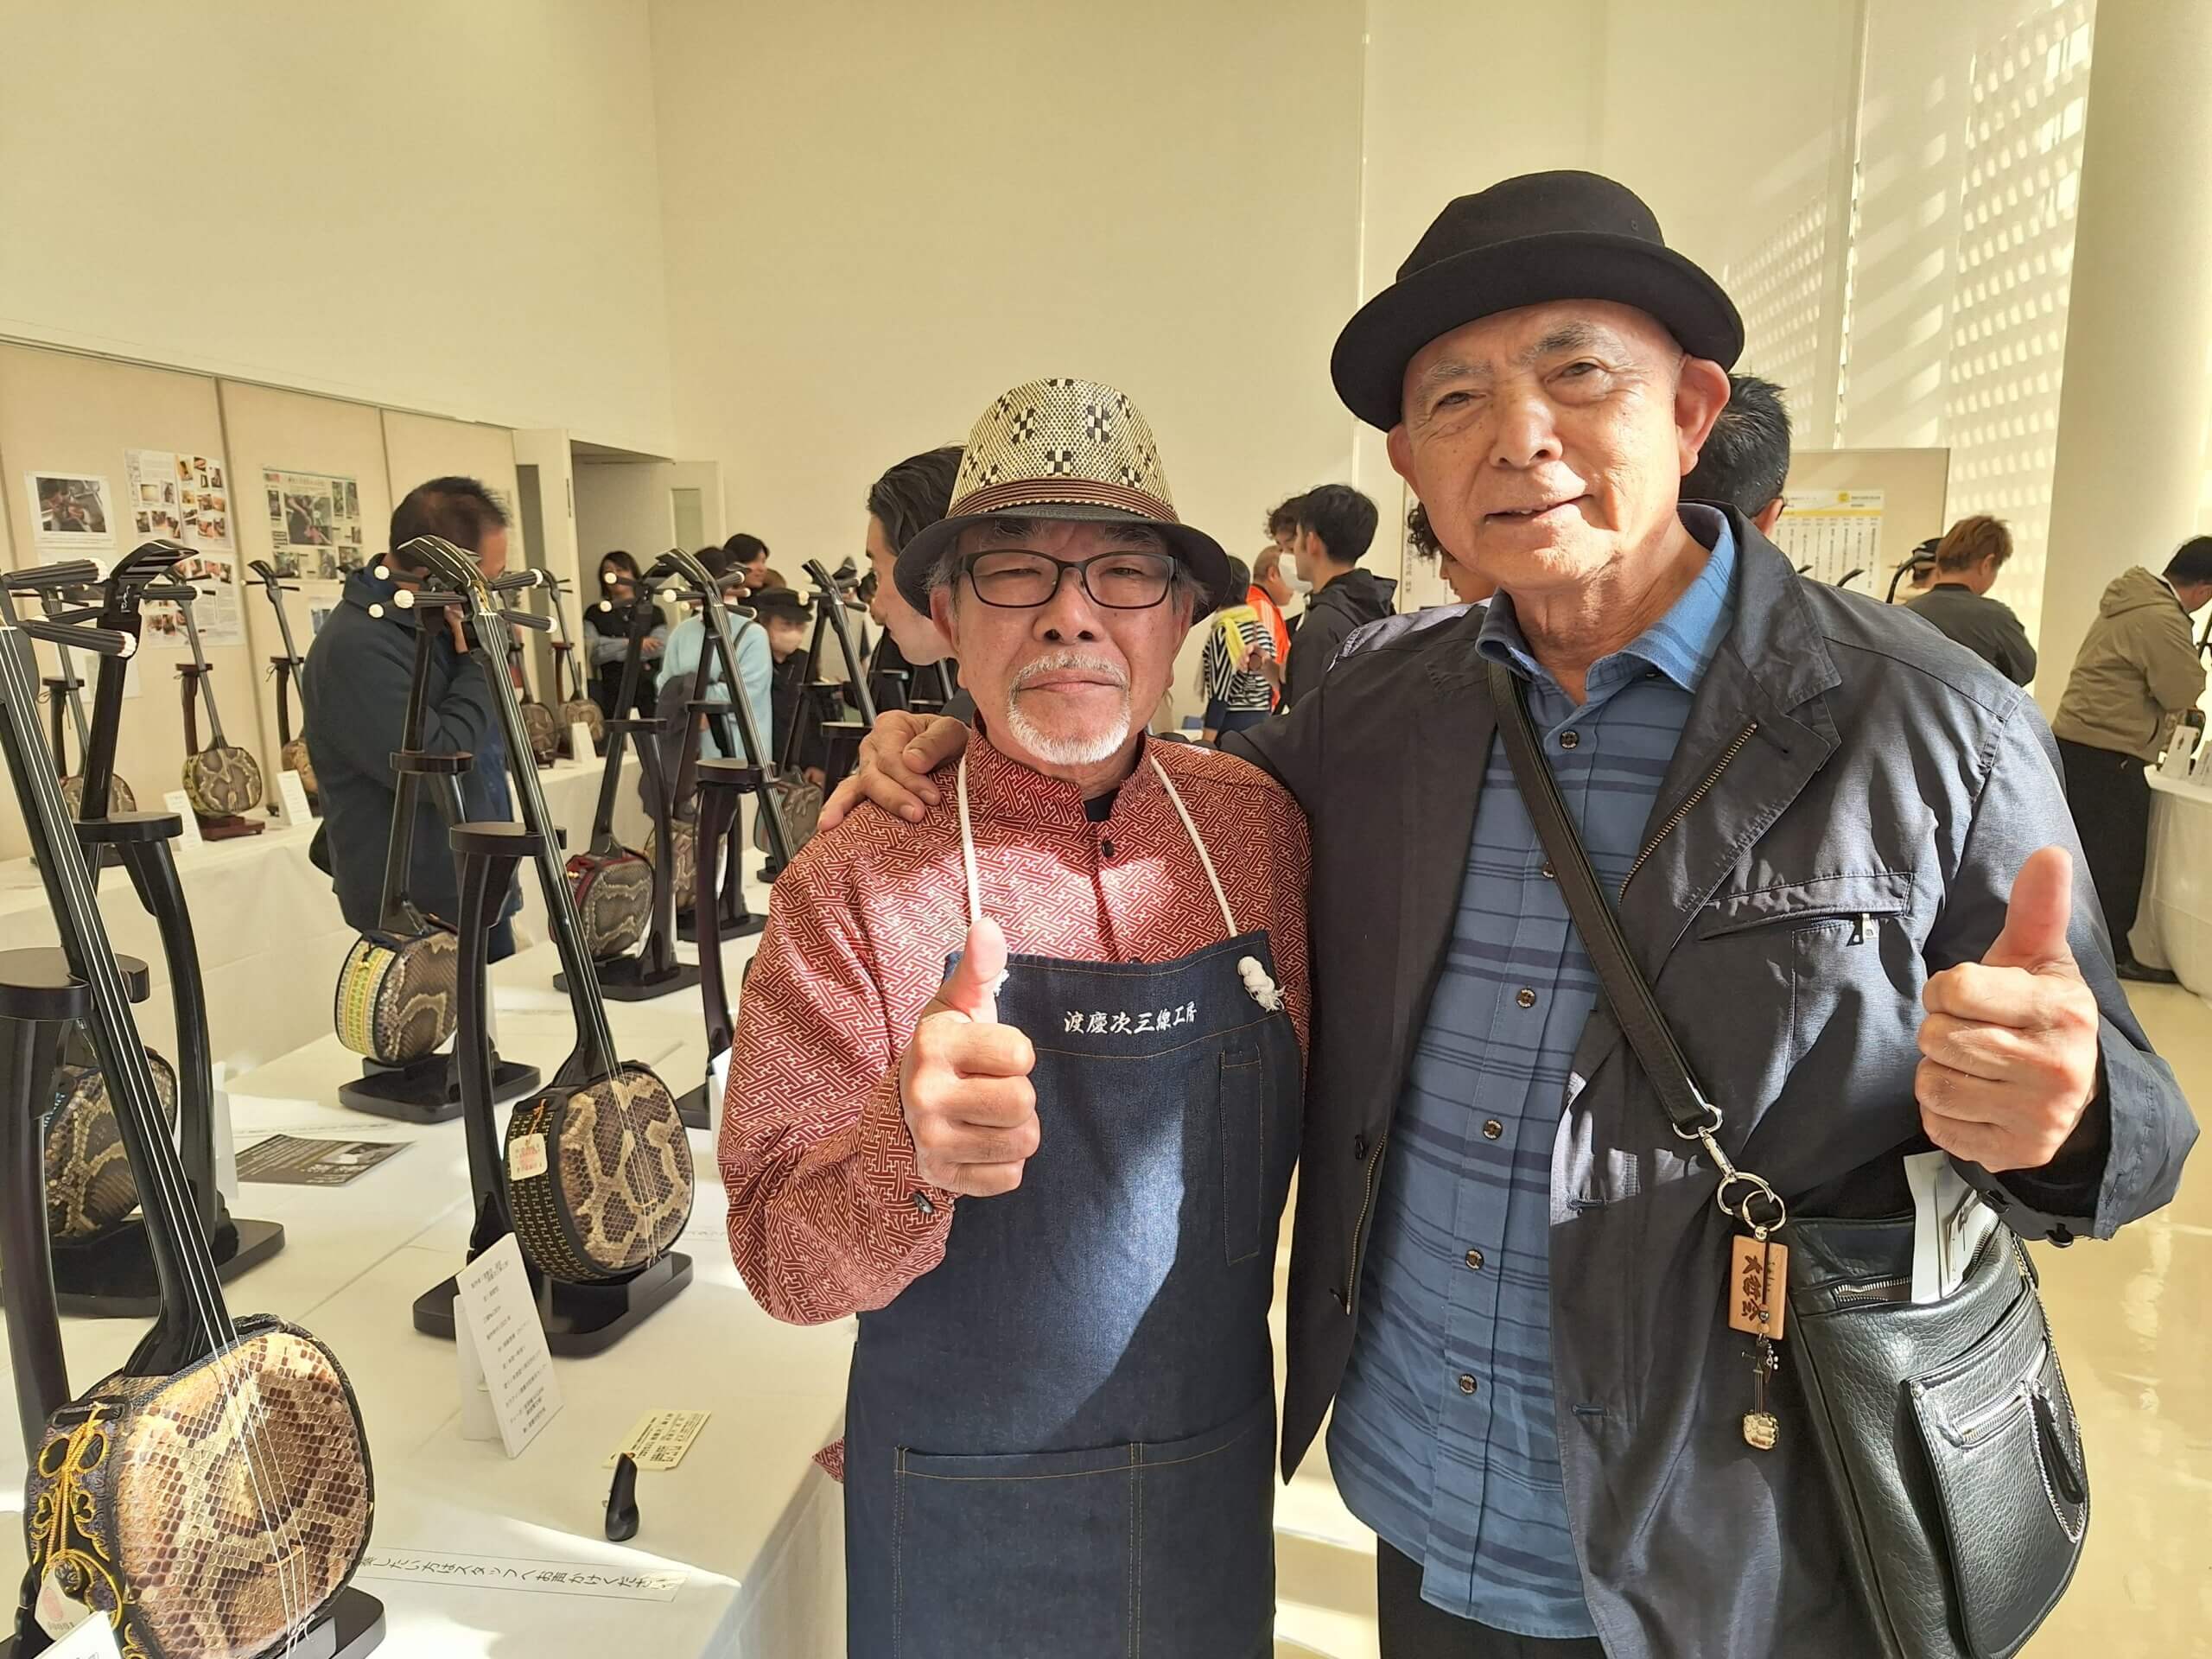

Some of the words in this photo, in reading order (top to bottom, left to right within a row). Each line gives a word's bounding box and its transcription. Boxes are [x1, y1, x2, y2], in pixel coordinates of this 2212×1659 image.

[1064, 1001, 1198, 1035] 渡慶次三線工房
